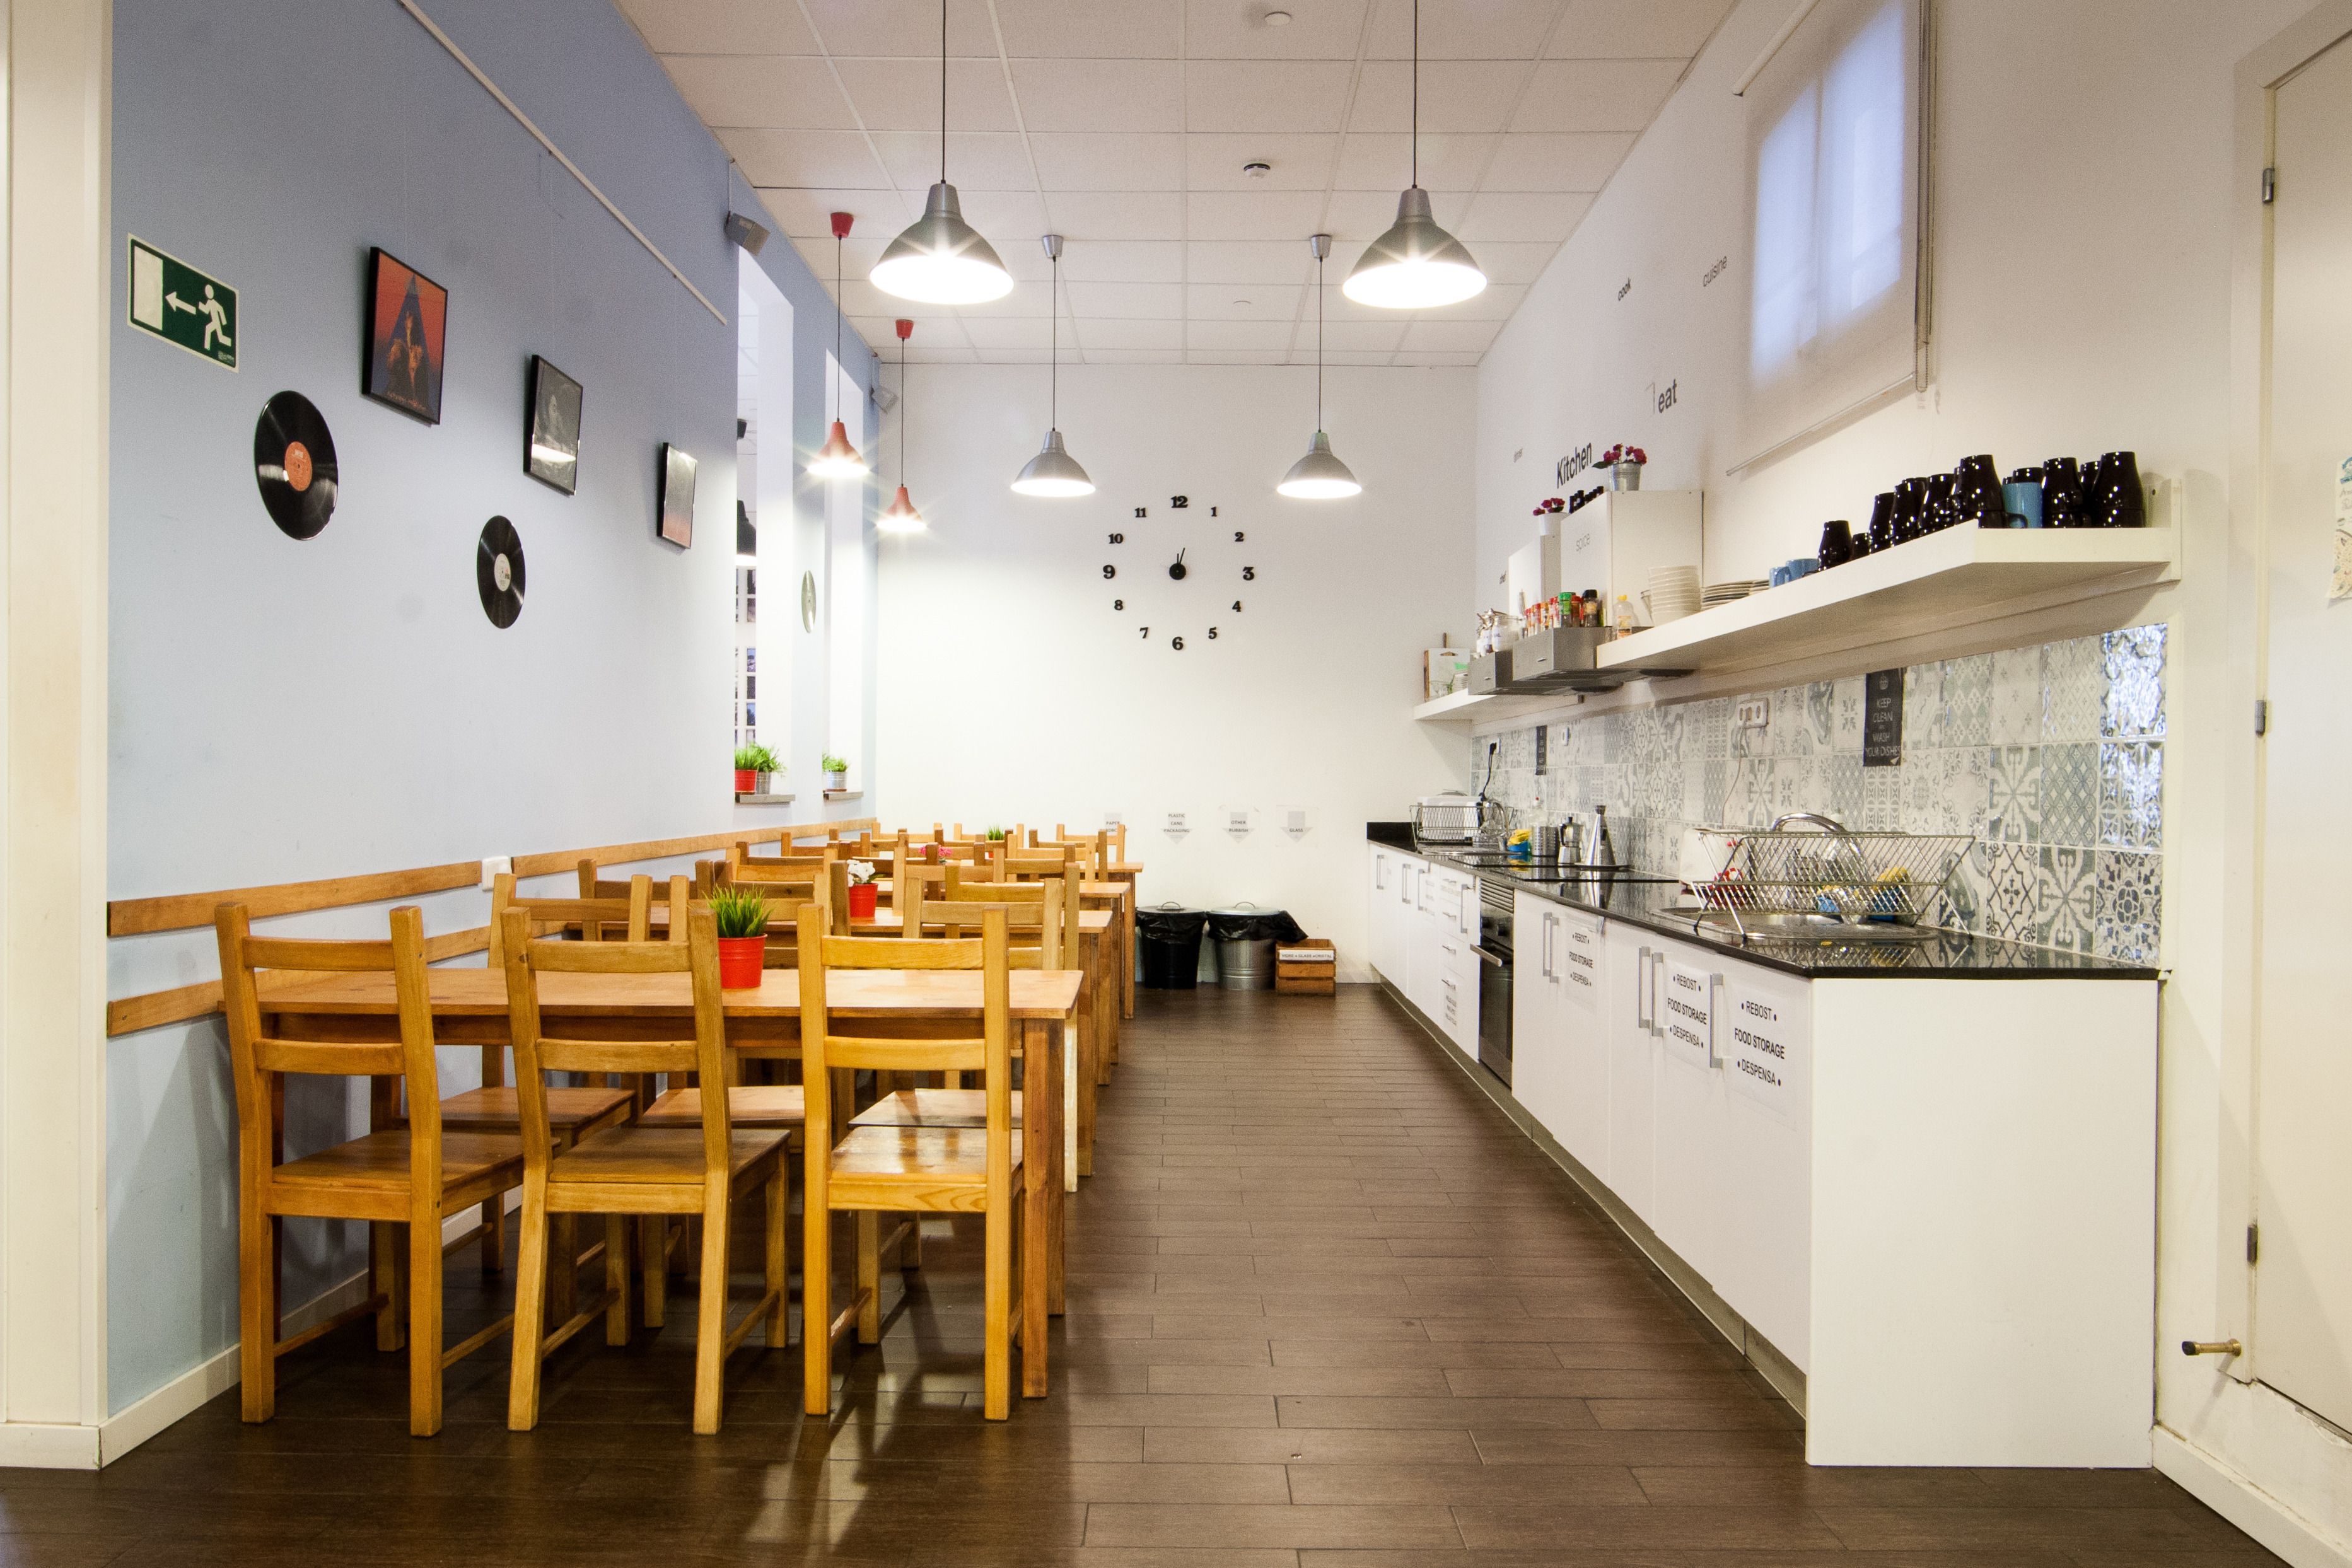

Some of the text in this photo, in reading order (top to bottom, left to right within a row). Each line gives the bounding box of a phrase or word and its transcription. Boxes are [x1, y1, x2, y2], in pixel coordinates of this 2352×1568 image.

[1703, 256, 1727, 287] cuisine
[1618, 277, 1631, 301] cook
[1658, 378, 1677, 414] eat
[1557, 442, 1592, 489] Kitchen
[1170, 496, 1188, 508] 12
[1135, 508, 1146, 518] 11
[1211, 506, 1217, 517] 1
[1108, 533, 1124, 543] 10
[1235, 531, 1244, 542] 2
[1103, 564, 1115, 579] 9
[1243, 566, 1254, 581] 3
[1114, 600, 1124, 610] 8
[1232, 601, 1242, 612] 4
[1139, 627, 1148, 639] 7
[1208, 627, 1218, 639] 5
[1172, 637, 1184, 650] 6
[1876, 697, 1892, 708] KEEP
[1873, 711, 1893, 723] CLEAN
[1872, 732, 1890, 743] WASH
[1575, 932, 1587, 944] REBOST
[1569, 951, 1593, 968] FOOD STORAGE
[1573, 972, 1589, 986] DESPENSA
[1677, 973, 1697, 992] REBOST
[1667, 997, 1708, 1025] FOOD STORAGE
[1746, 1001, 1772, 1020] REBOST
[1673, 1025, 1700, 1047] DESPENSA
[1735, 1027, 1785, 1059] FOOD STORAGE
[1742, 1059, 1776, 1085] DESPENSA
